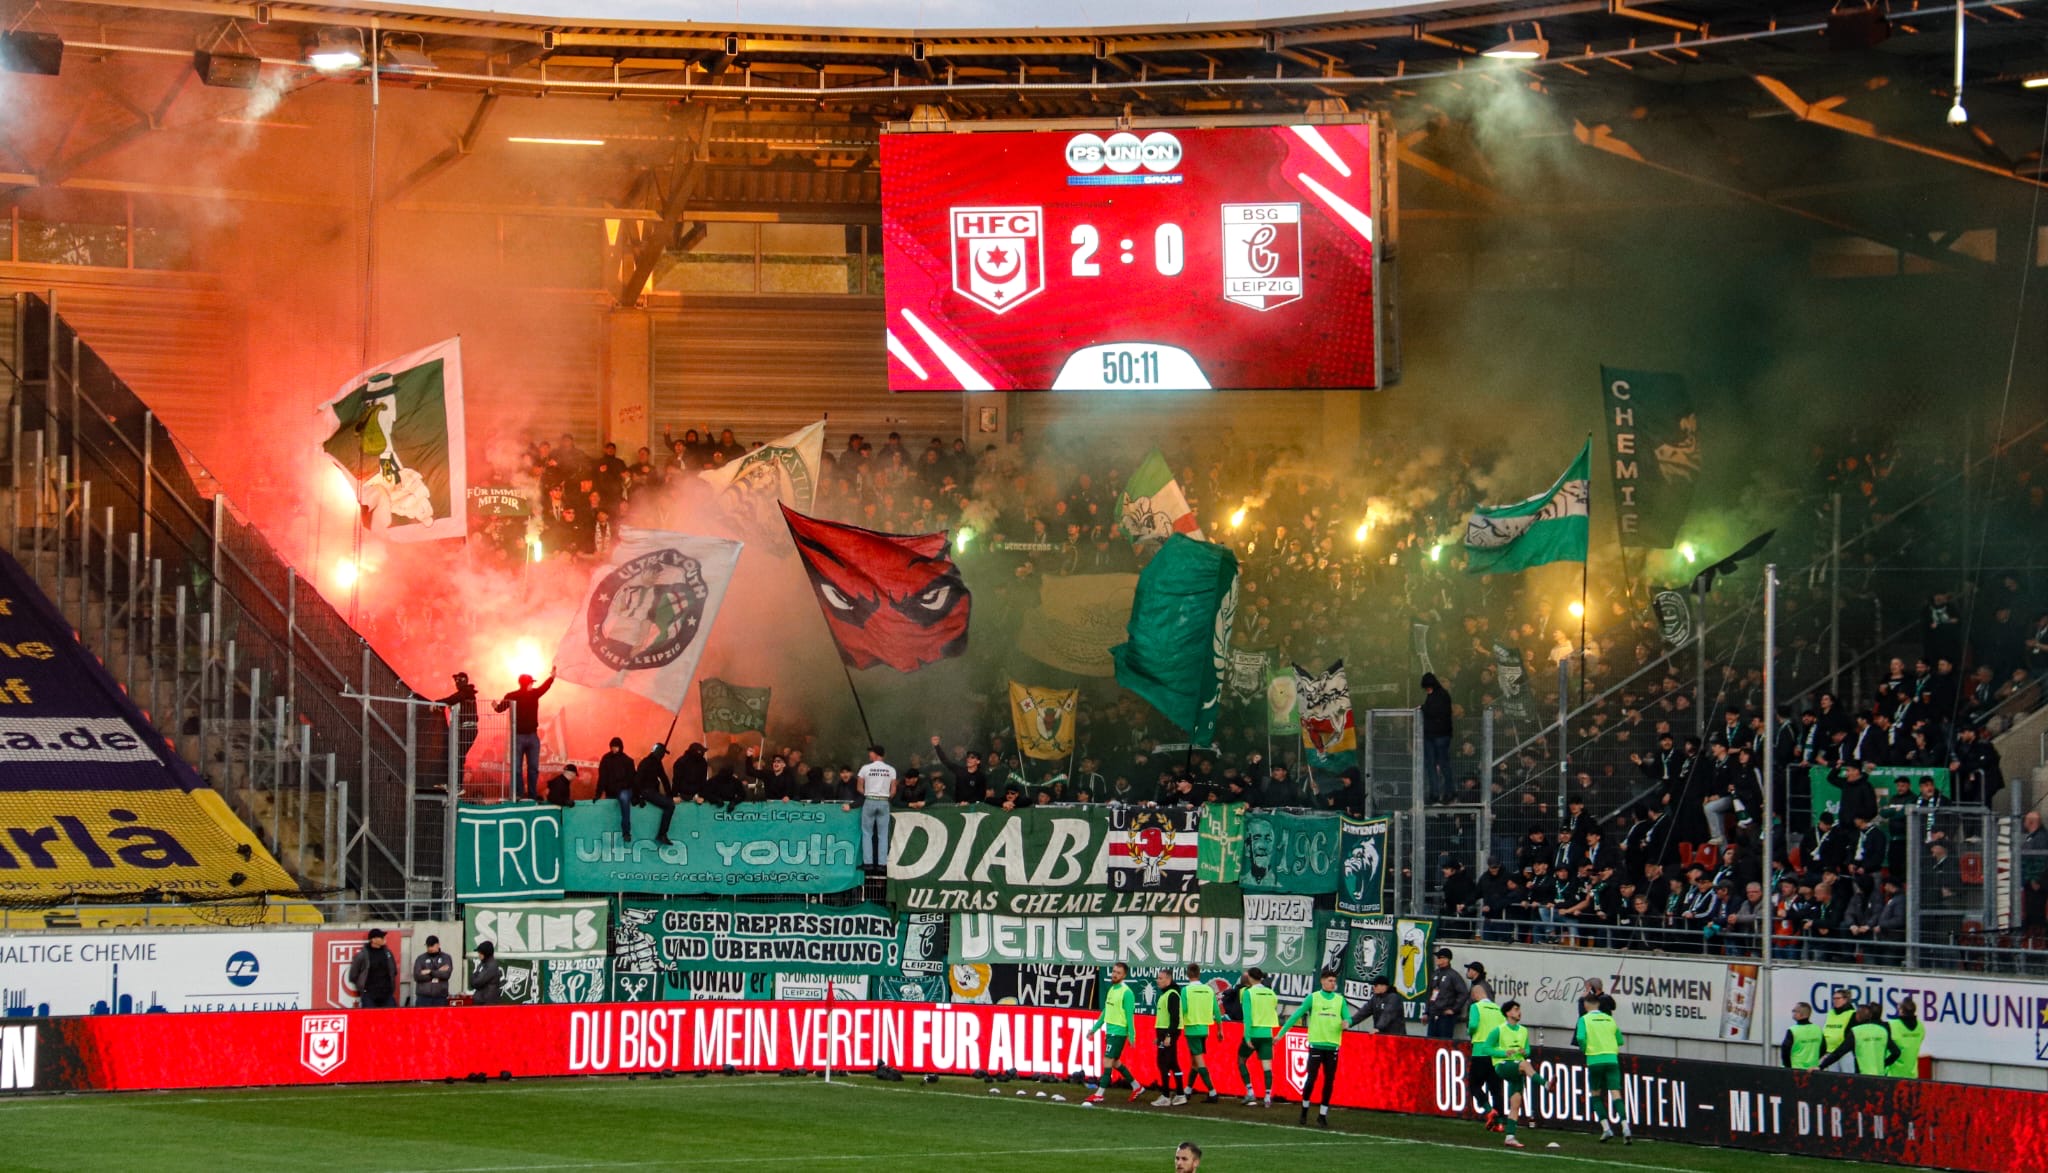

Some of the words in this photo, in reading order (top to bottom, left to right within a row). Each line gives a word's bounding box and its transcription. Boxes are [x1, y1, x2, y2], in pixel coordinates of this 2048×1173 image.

[1072, 145, 1101, 161] PS
[1105, 144, 1175, 162] UNION
[1144, 174, 1184, 184] GROUP
[962, 215, 1031, 235] HFC
[1242, 208, 1280, 221] BSG
[1070, 223, 1101, 277] 2
[1154, 222, 1185, 277] 0
[1232, 280, 1295, 294] LEIPZIG
[1102, 350, 1160, 385] 50:11
[1611, 380, 1639, 535] CHEMIE
[466, 486, 489, 499] FÜR
[478, 496, 499, 508] MIT
[501, 496, 520, 510] DIR
[0, 726, 139, 751] a.de
[1112, 809, 1127, 830] U
[1182, 811, 1198, 831] F
[461, 815, 560, 888] TRC
[1113, 870, 1127, 889] 9
[1181, 874, 1195, 892] 7
[905, 887, 999, 912] ULTRAS
[1008, 891, 1107, 915] CHEMIE
[1110, 892, 1201, 914] LEIPZIG
[1246, 895, 1314, 922] WURZEN
[662, 910, 730, 935] GEGEN
[735, 913, 898, 939] REPRESSIONEN
[919, 912, 943, 923] BSG
[474, 909, 599, 954] SKINS
[80, 943, 158, 963] CHEMIE
[663, 937, 710, 963] UND
[713, 931, 885, 965] ÜBERWACHUNG
[905, 961, 943, 971] LEIPZIG
[784, 989, 821, 998] LEIPZIG
[1017, 969, 1097, 1008] WEST
[1534, 976, 1568, 1004] Edel
[1609, 974, 1712, 1001] ZUSAMMEN
[1631, 1001, 1672, 1018] WIRD'S
[1675, 1004, 1708, 1020] EDEL.
[308, 1019, 342, 1033] HFC
[569, 1011, 613, 1071] DU
[618, 1009, 685, 1069] BIST
[696, 1007, 778, 1068] MEIN
[788, 1007, 904, 1067] VEREIN
[911, 1002, 981, 1070] FÜR
[988, 1012, 1064, 1075] ALLE
[1066, 1016, 1108, 1078] ZEI
[0, 1025, 38, 1089] N
[1435, 1048, 1466, 1112] OB
[1729, 1089, 1782, 1135] MIT
[1797, 1100, 1843, 1139] DIR
[1857, 1111, 1885, 1140] IN
